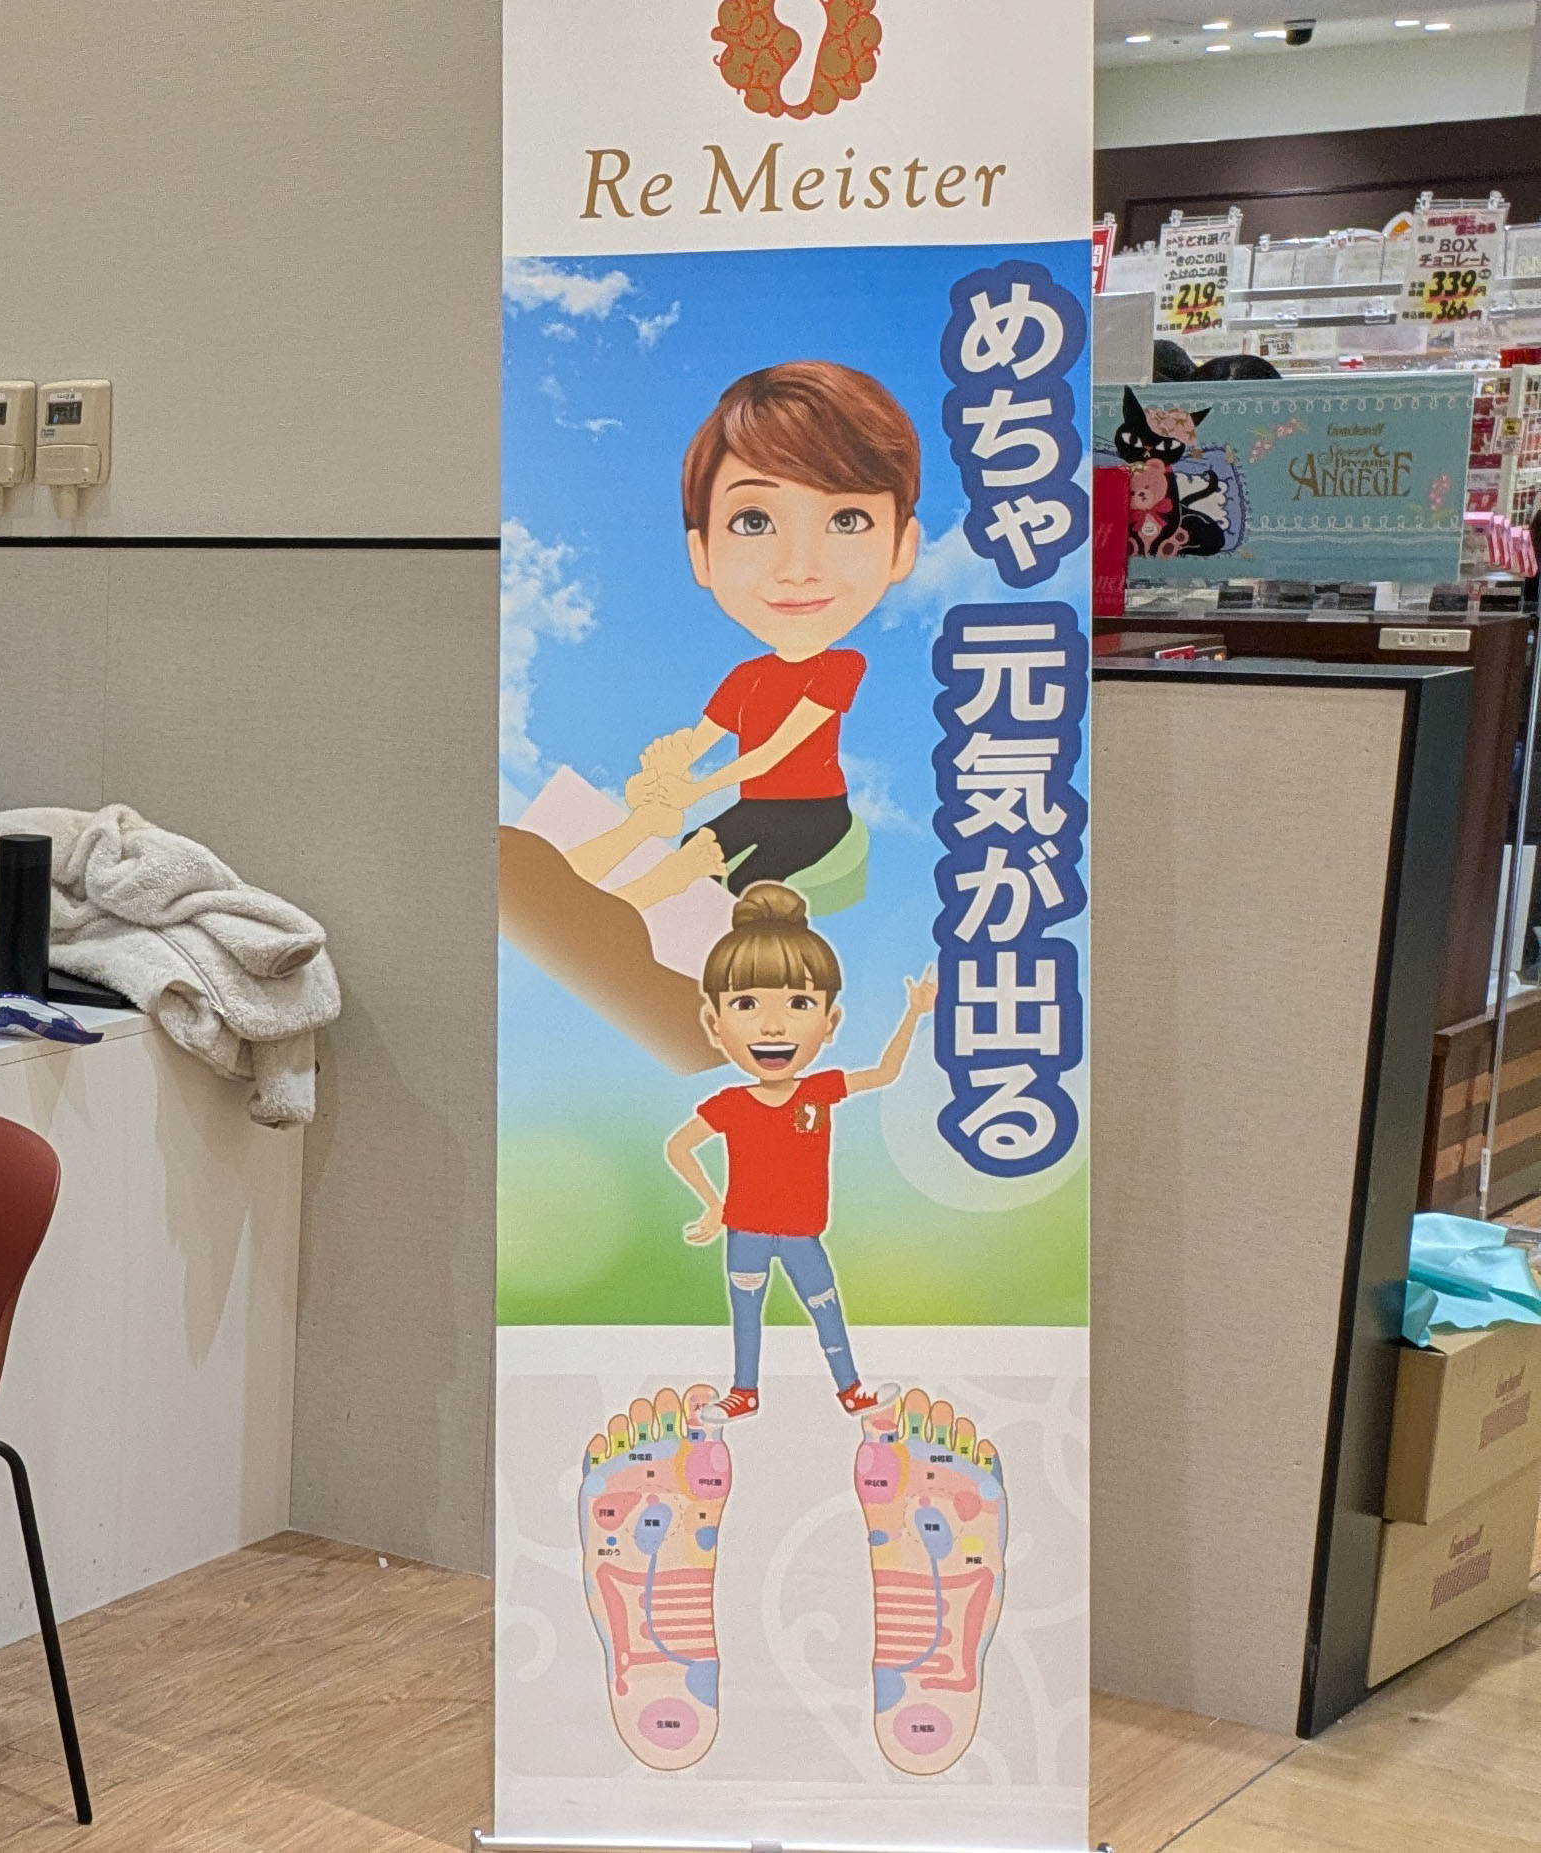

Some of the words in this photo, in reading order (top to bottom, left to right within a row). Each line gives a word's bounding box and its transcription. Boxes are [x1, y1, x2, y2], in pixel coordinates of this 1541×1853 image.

[580, 146, 673, 220] Re
[699, 142, 1007, 216] Meister
[1419, 252, 1491, 267] チョコレート
[1439, 239, 1477, 252] BOX
[960, 283, 1072, 573] めちゃ
[949, 622, 1070, 1160] 元気が出る
